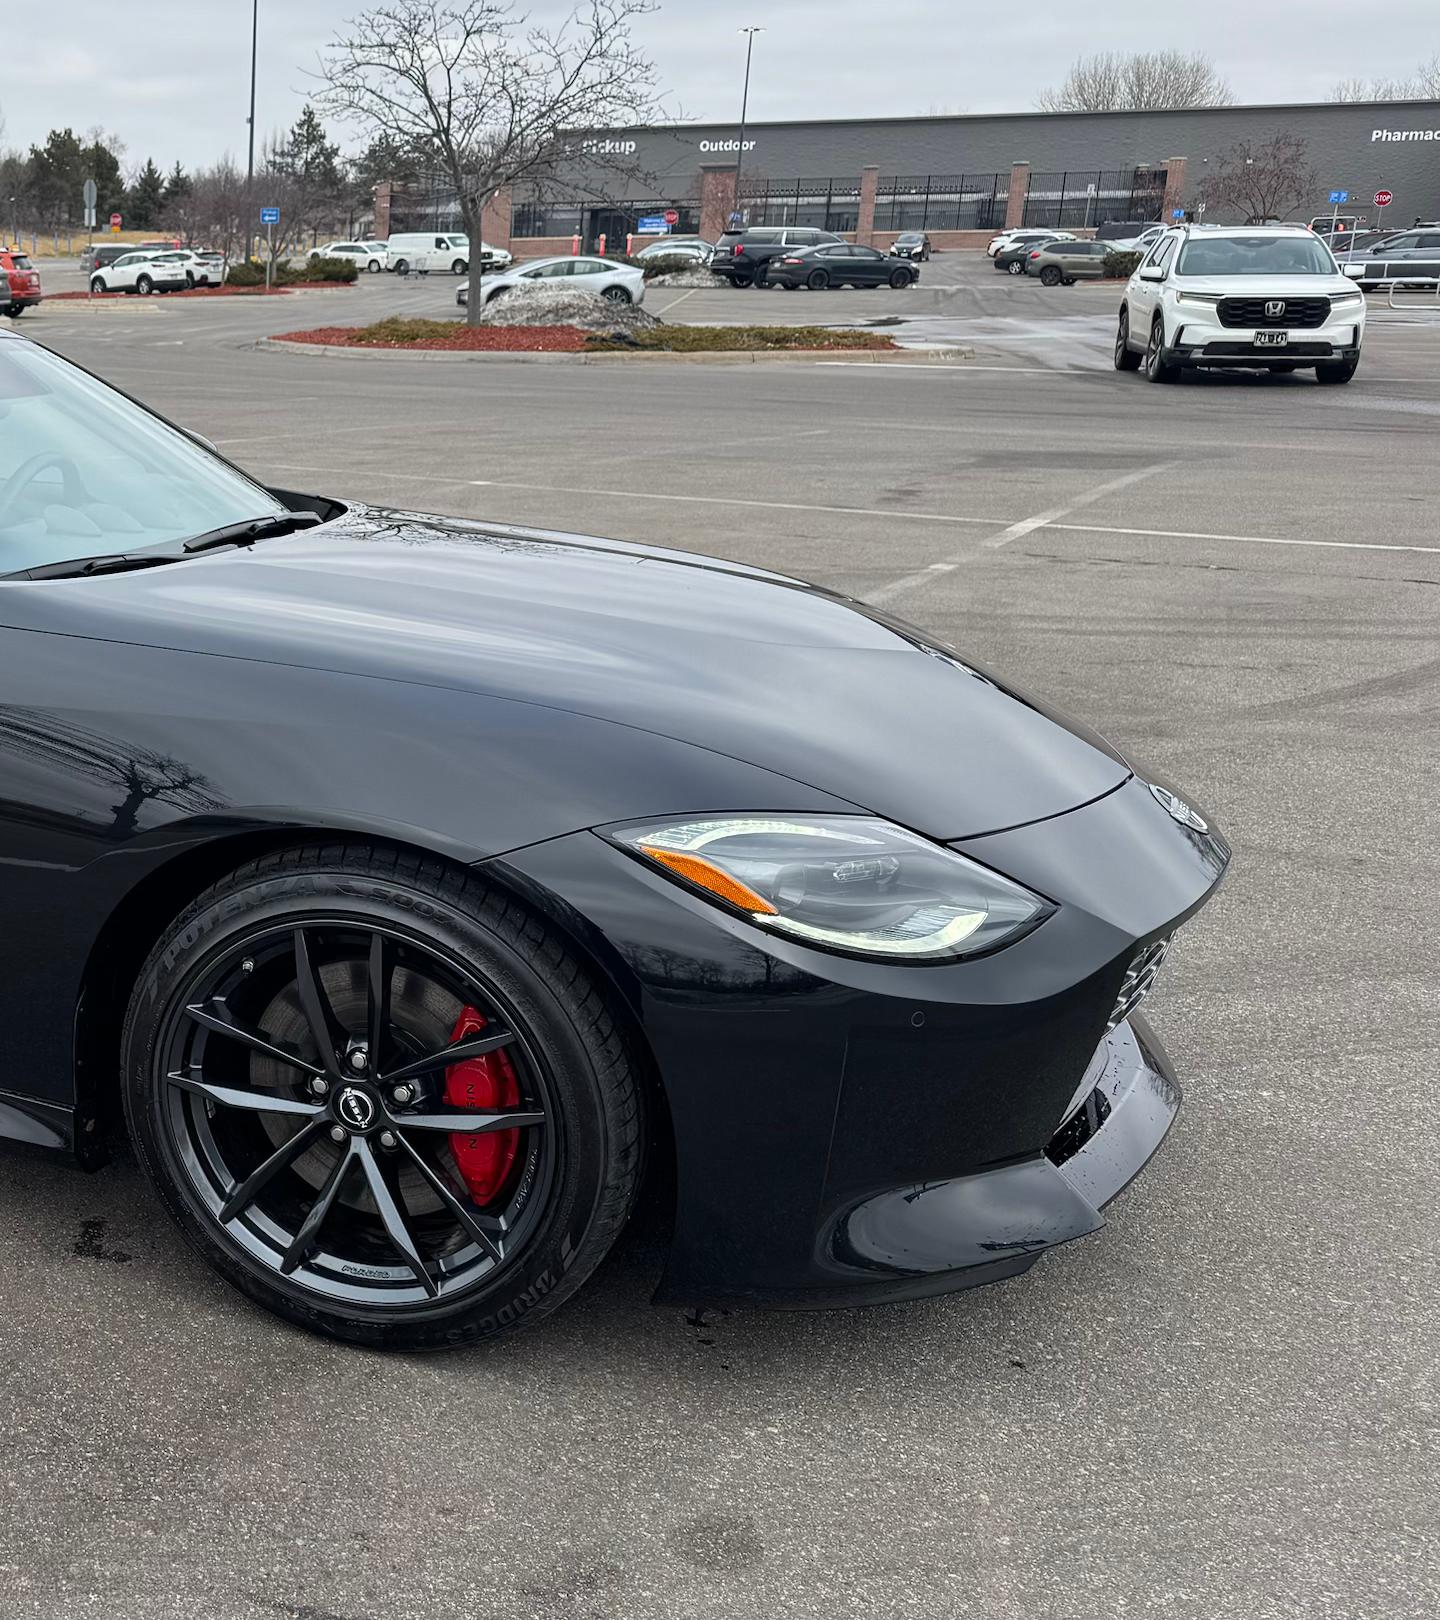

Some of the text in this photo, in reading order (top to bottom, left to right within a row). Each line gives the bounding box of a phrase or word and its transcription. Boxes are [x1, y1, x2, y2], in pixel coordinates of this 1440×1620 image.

[1371, 129, 1440, 142] Pharmac
[582, 139, 636, 155] Pickup
[699, 139, 756, 152] Outdoor
[1375, 194, 1391, 202] STOP
[343, 1086, 368, 1129] NISSAN
[465, 1083, 478, 1150] NISN
